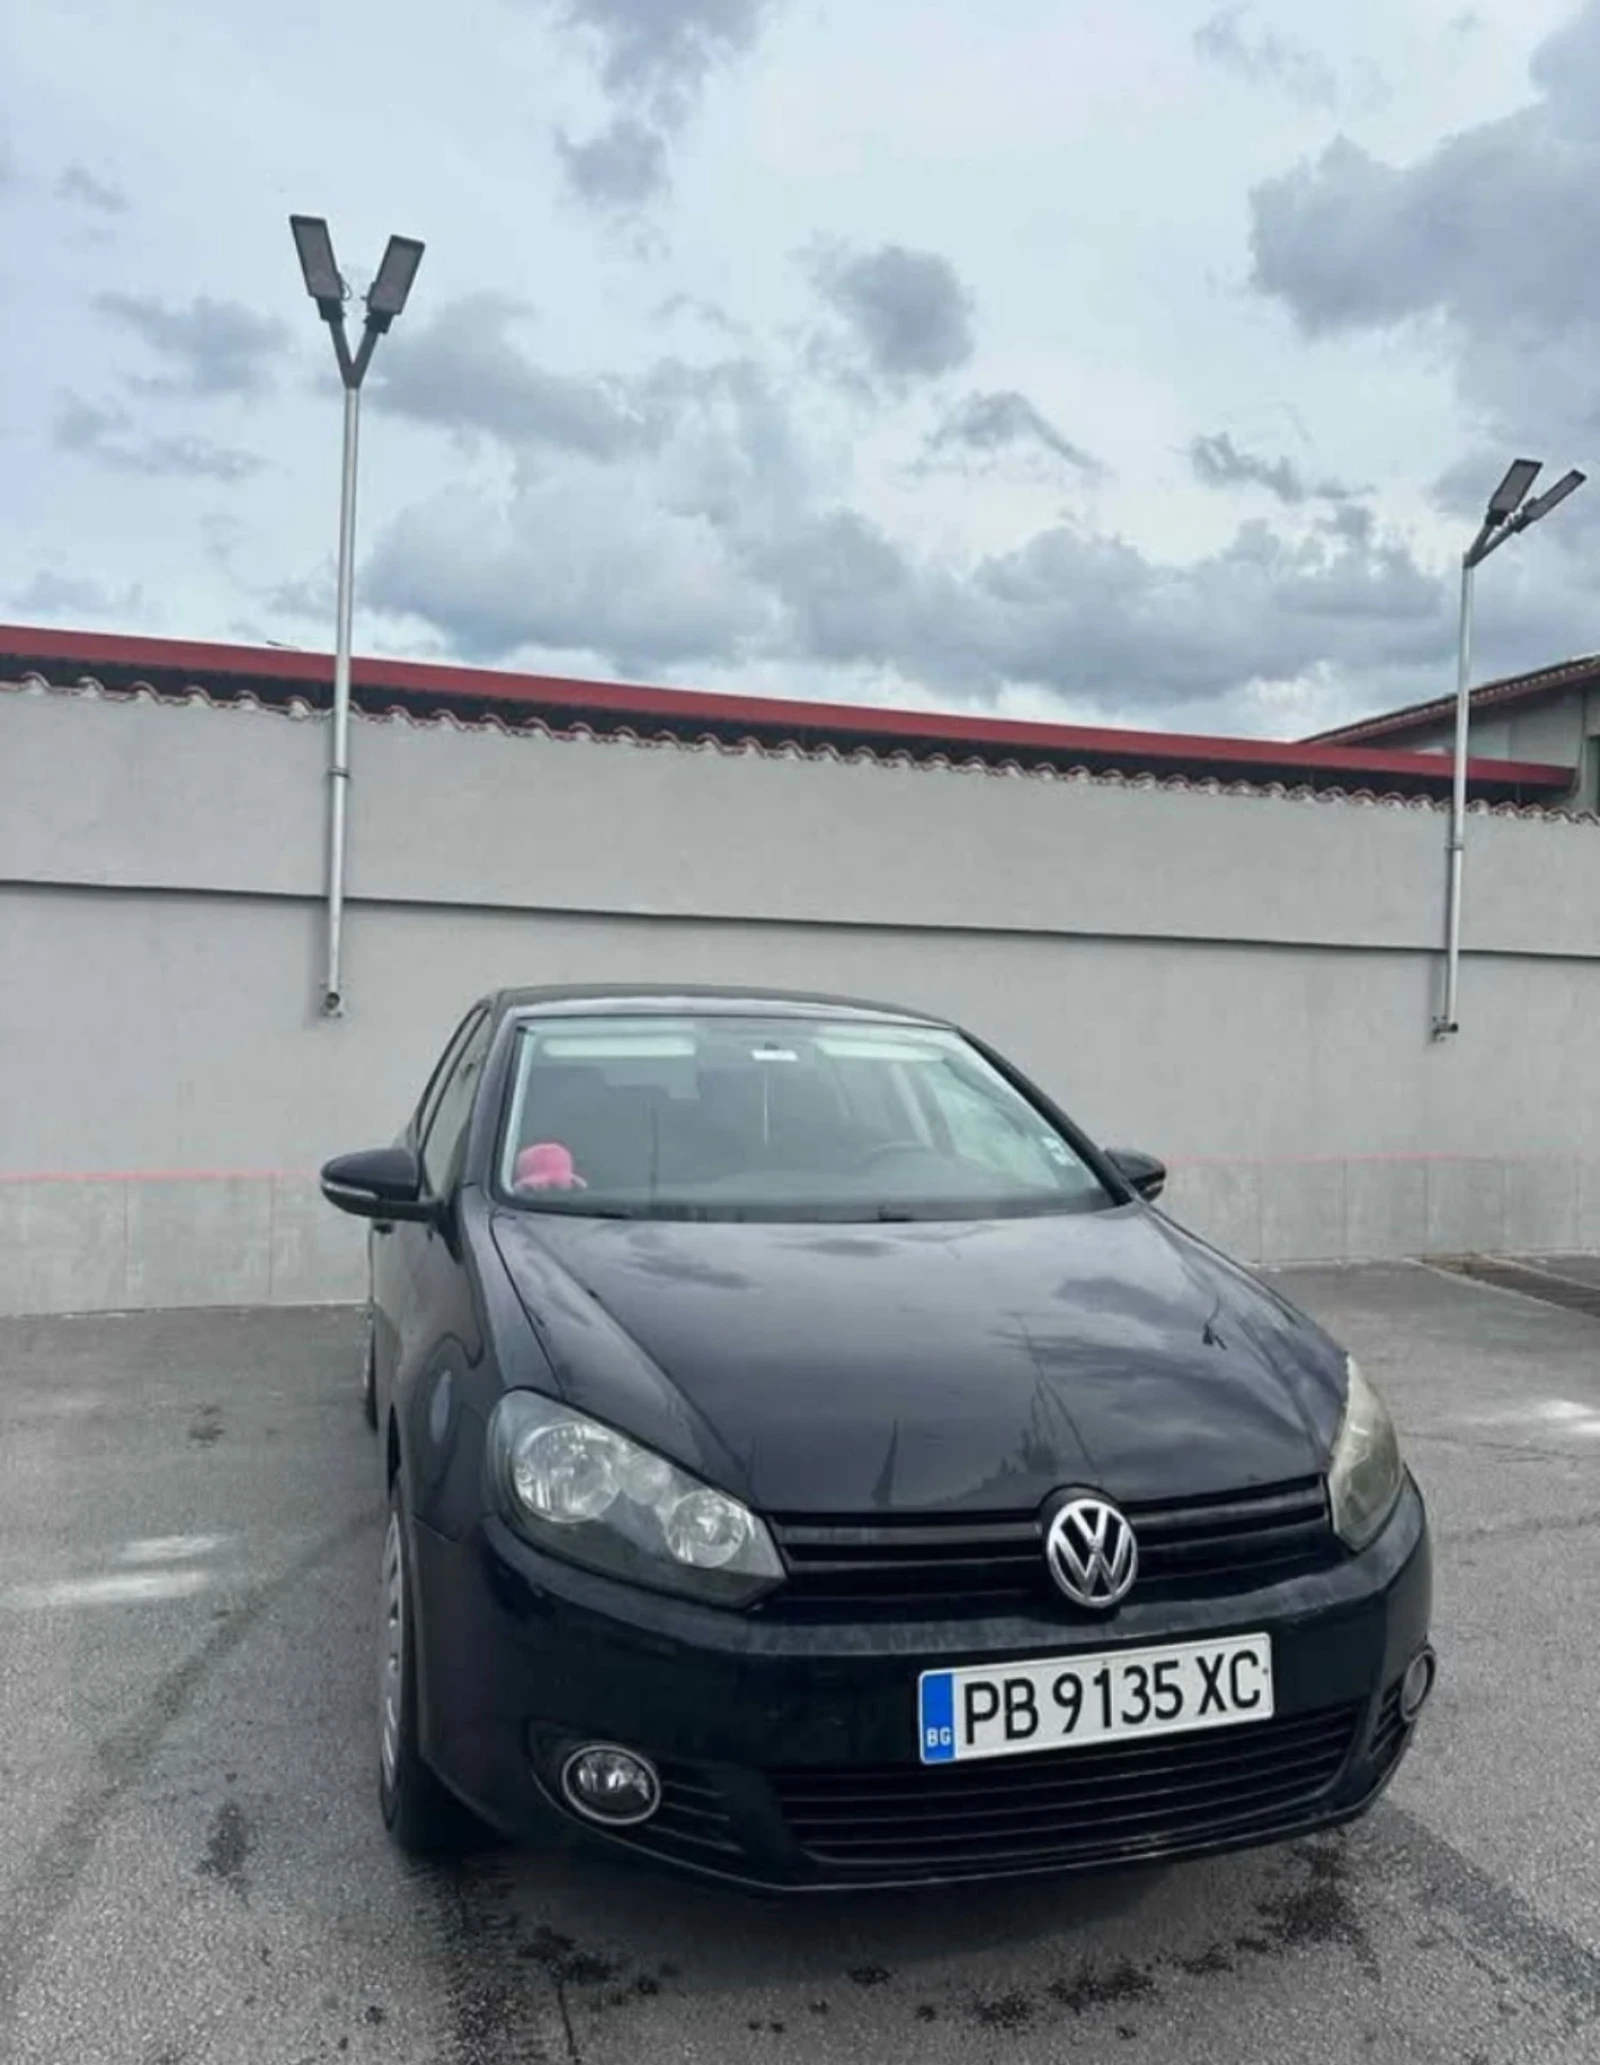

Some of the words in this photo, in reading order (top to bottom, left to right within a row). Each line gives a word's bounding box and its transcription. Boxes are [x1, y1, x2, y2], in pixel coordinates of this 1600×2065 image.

[1050, 1500, 1136, 1605] VW
[926, 1727, 952, 1748] BG
[964, 1678, 1039, 1745] PB
[1053, 1660, 1184, 1734] 9135
[1195, 1650, 1262, 1716] XC
